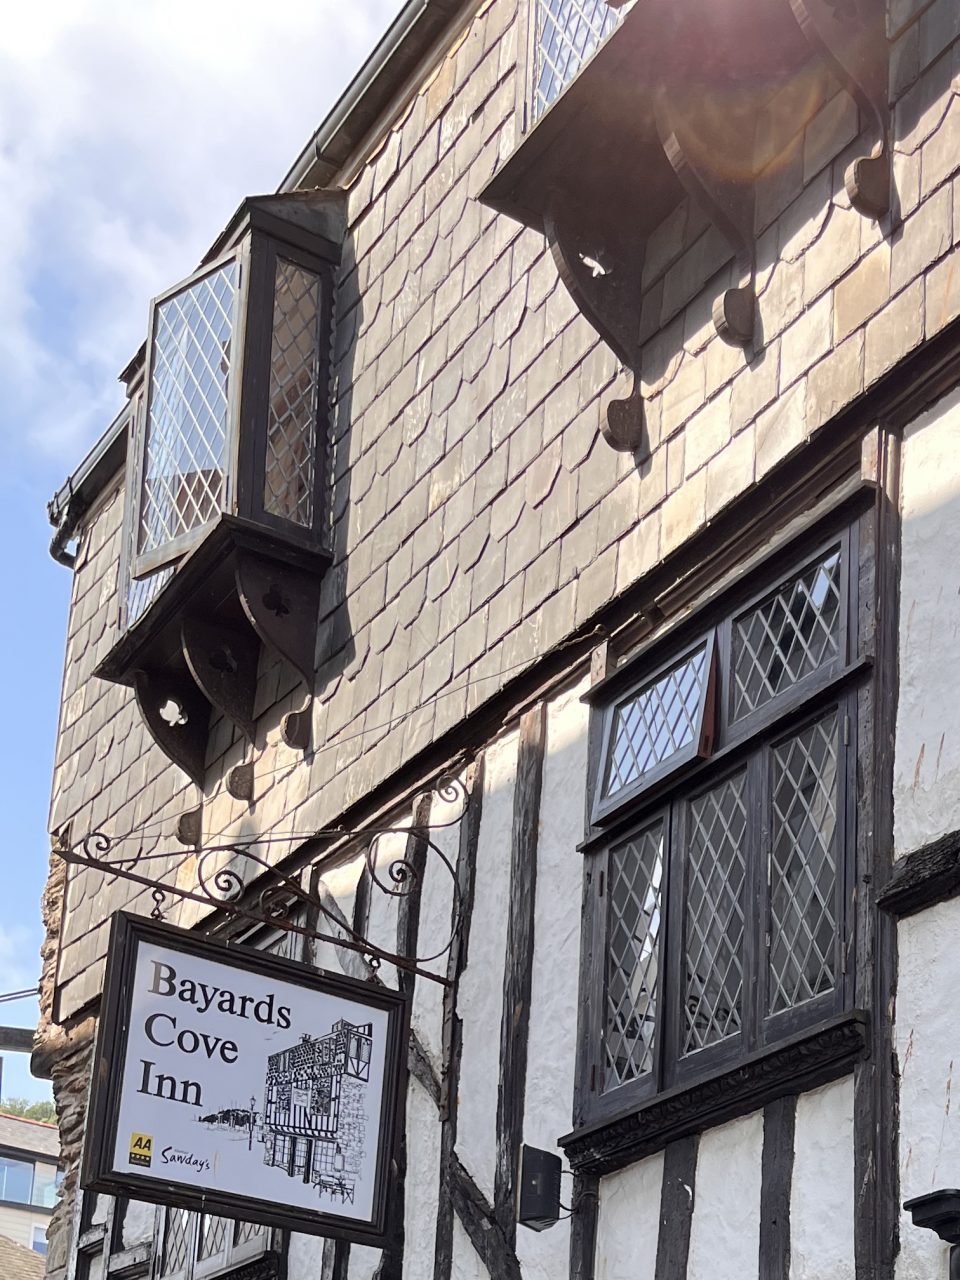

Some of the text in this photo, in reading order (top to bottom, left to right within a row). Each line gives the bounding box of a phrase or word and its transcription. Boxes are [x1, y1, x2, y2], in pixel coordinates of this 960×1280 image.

[147, 960, 292, 1030] Bayards
[144, 1012, 239, 1064] Cove
[136, 1059, 203, 1108] Inn
[133, 1136, 152, 1152] AA
[161, 1146, 210, 1173] Sawday's
